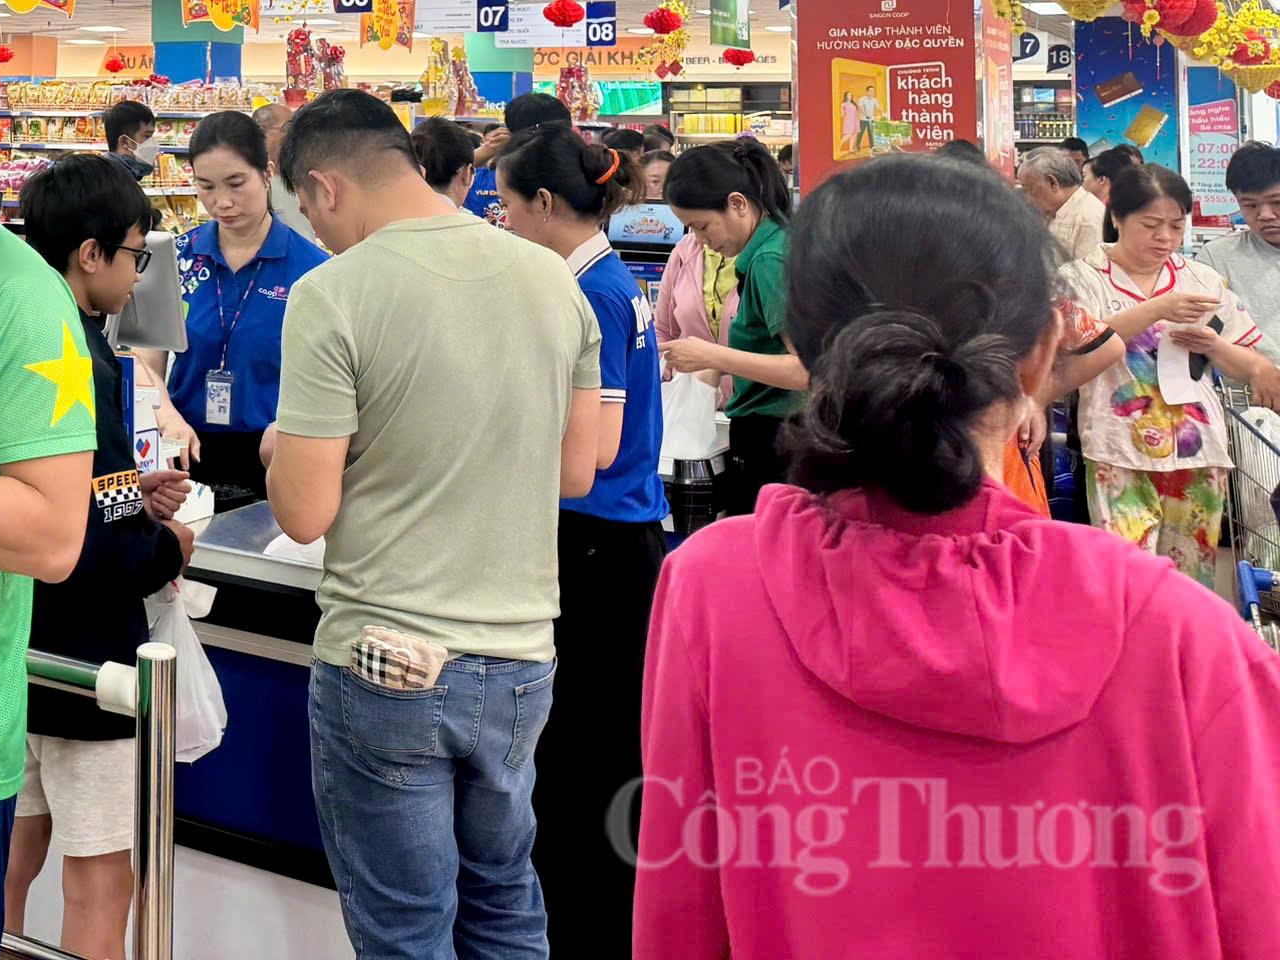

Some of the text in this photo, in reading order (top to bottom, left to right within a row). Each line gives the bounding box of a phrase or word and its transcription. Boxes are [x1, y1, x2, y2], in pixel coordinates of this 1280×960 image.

[480, 6, 505, 27] 07
[588, 23, 614, 42] 08
[829, 24, 951, 38] GIA NHẬP THÀNH VIÊN
[816, 37, 964, 50] HƯỞNG NGAY ĐẶC QUYỀN
[686, 56, 711, 65] BEER
[1049, 50, 1070, 64] 18
[897, 74, 952, 90] khách
[908, 91, 953, 108] hàng
[901, 108, 953, 123] thành
[1207, 105, 1230, 115] nghe
[916, 125, 954, 140] viên
[97, 472, 137, 491] SPEED
